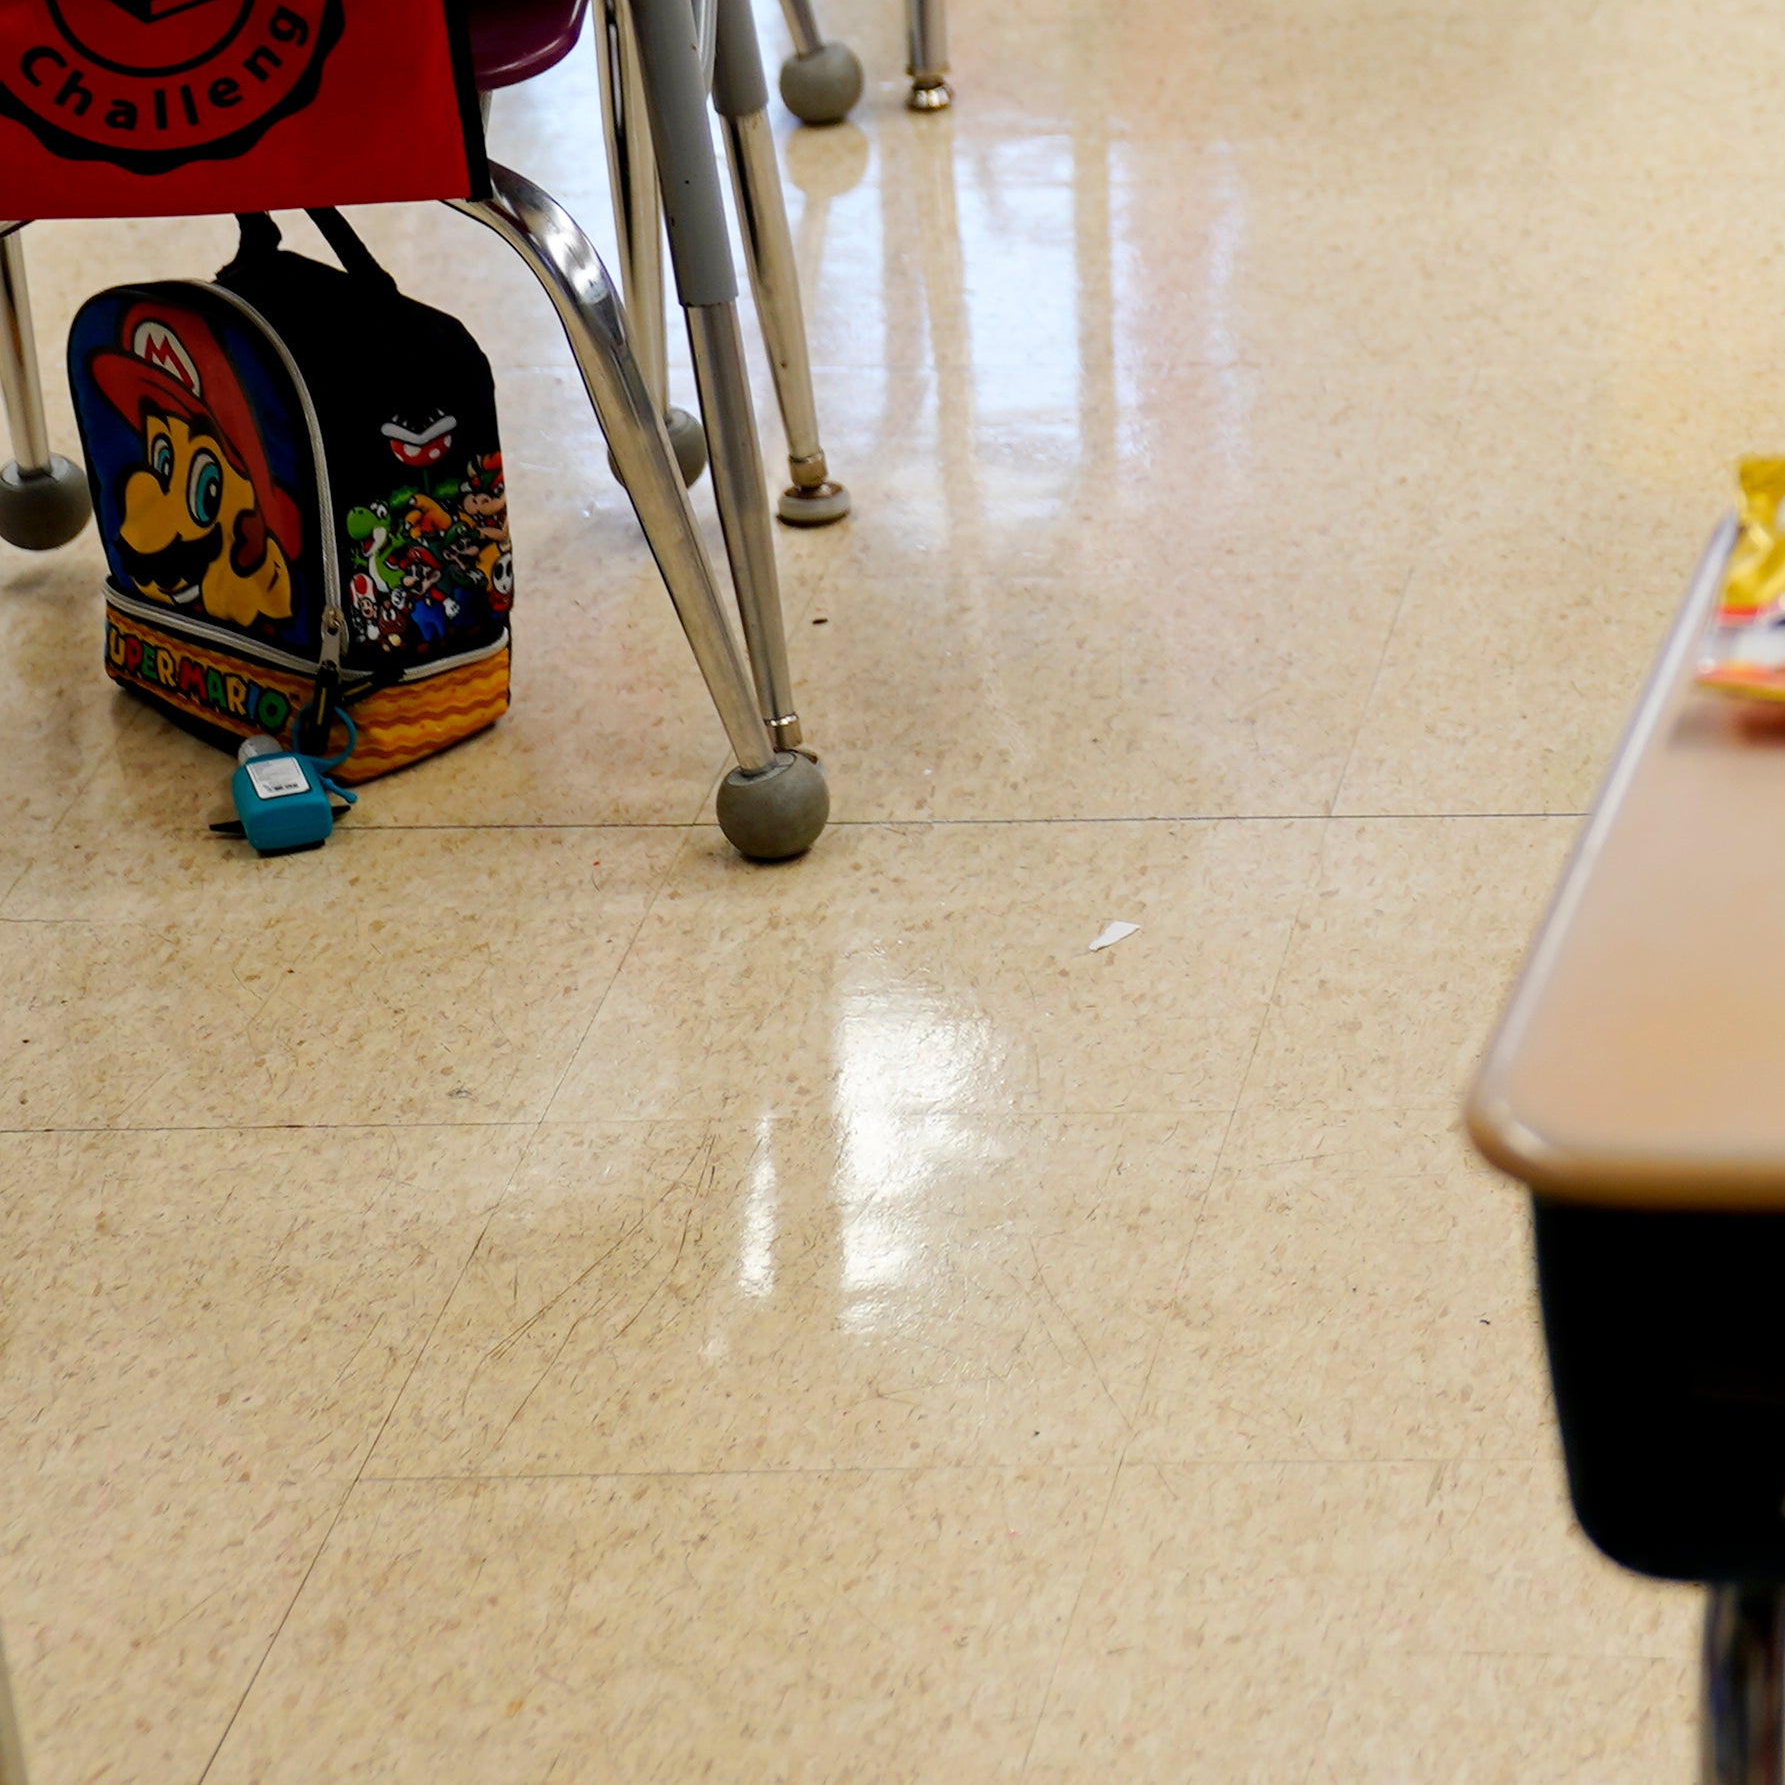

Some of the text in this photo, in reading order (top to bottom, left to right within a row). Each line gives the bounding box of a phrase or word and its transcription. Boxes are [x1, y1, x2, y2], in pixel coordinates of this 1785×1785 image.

[144, 333, 196, 390] M
[105, 626, 290, 730] UPER MARIO
